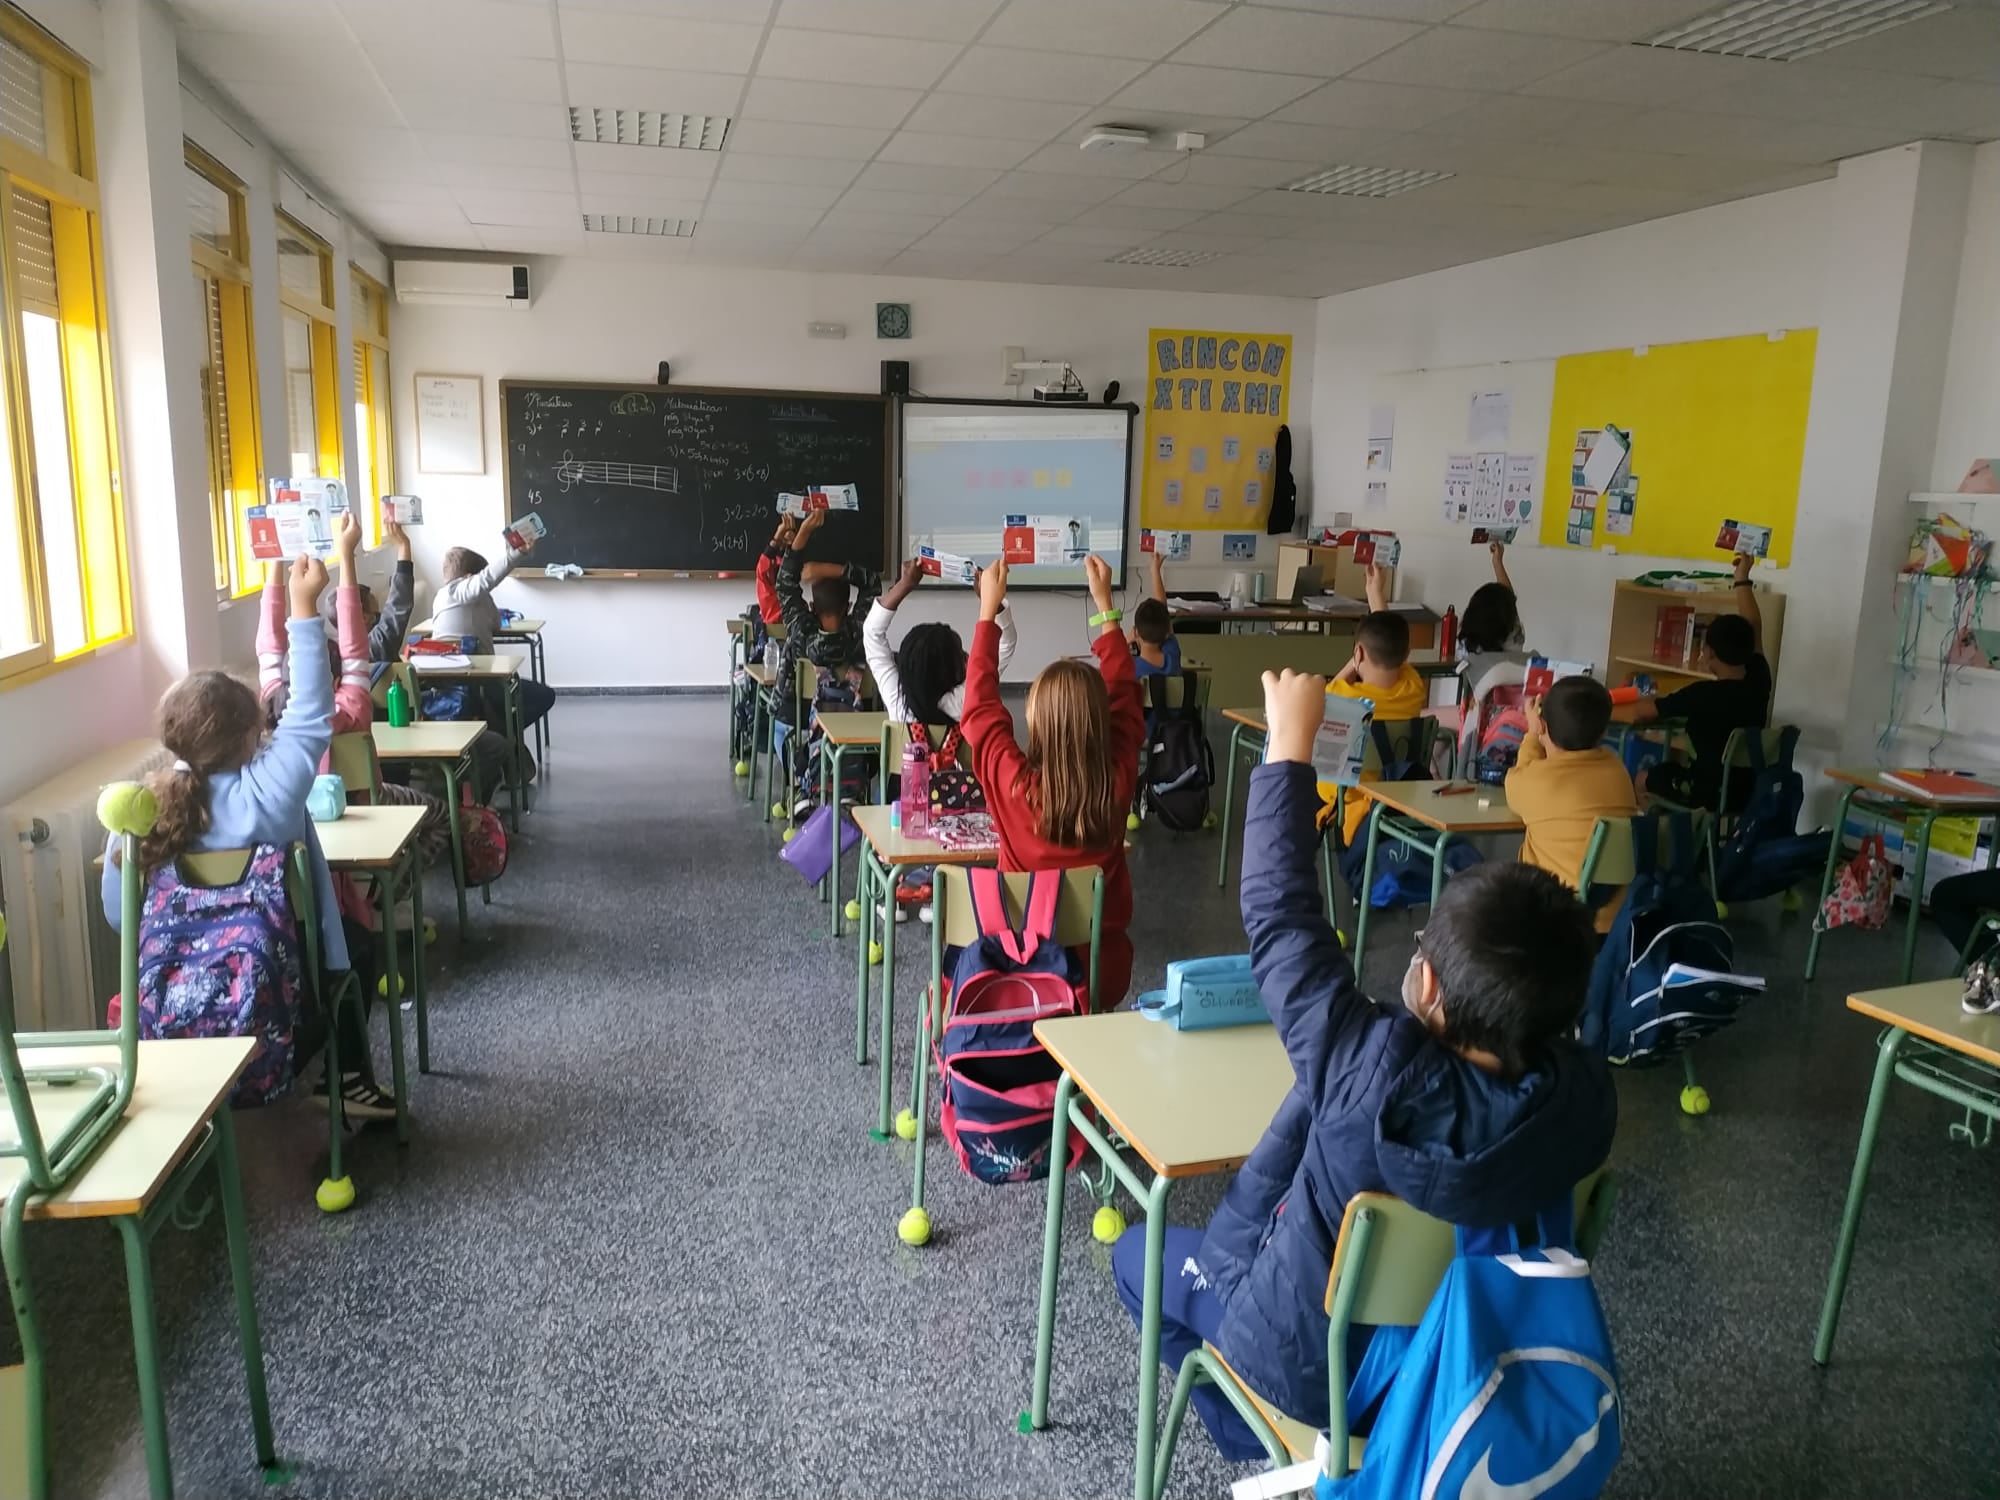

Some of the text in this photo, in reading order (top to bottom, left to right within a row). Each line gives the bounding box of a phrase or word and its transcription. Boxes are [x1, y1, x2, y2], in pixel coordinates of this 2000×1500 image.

[1157, 336, 1285, 376] RINCON
[1154, 378, 1281, 416] XTI XMI
